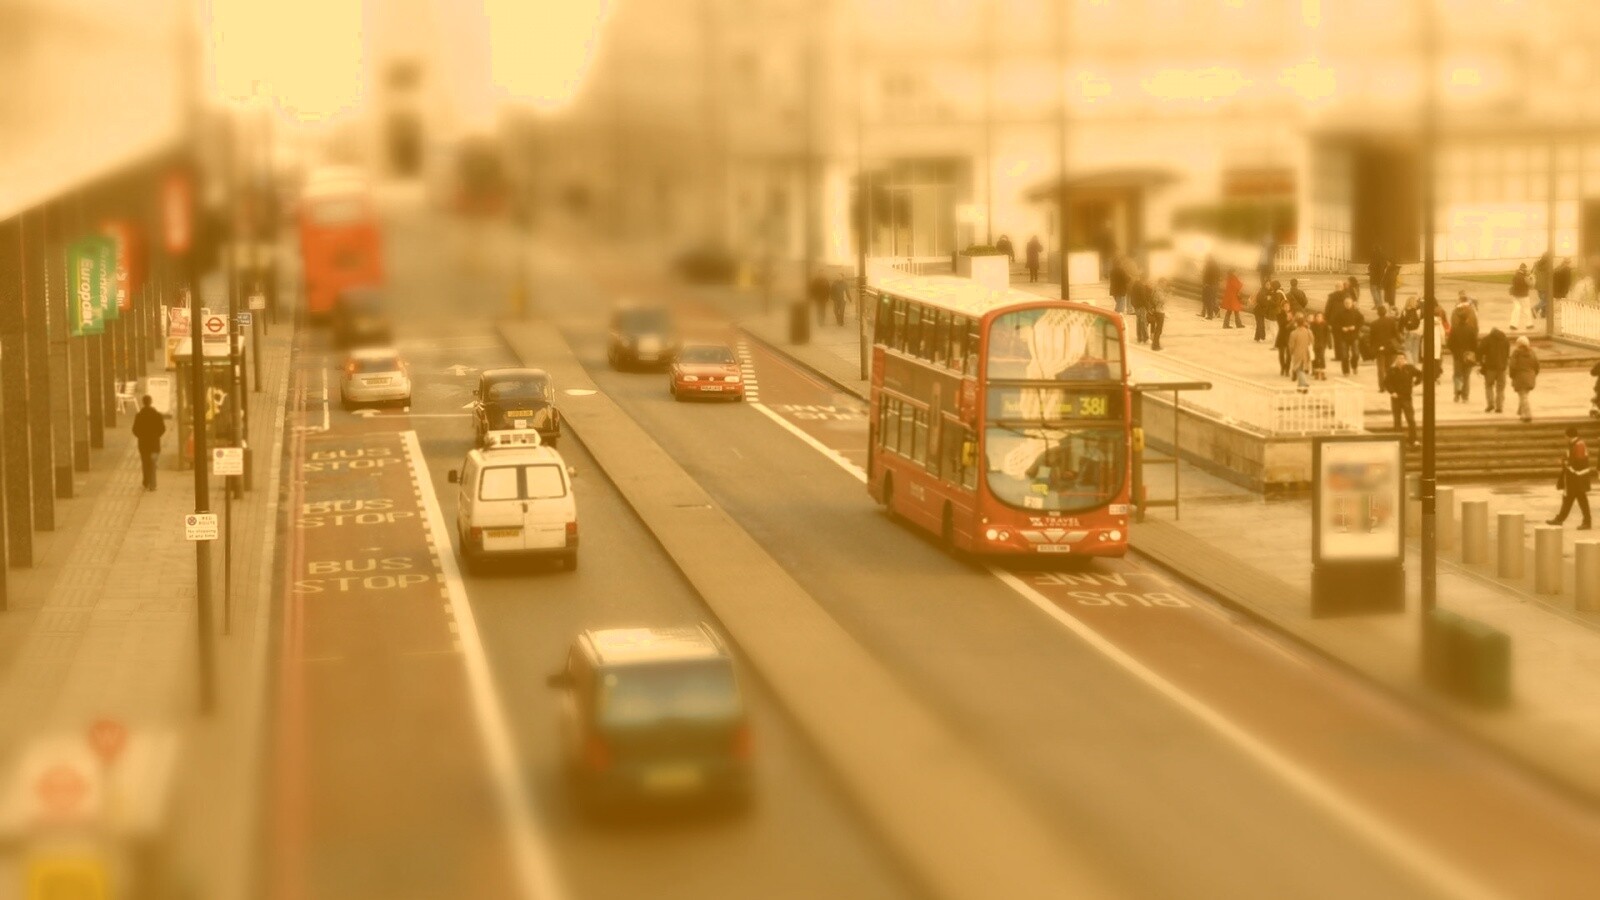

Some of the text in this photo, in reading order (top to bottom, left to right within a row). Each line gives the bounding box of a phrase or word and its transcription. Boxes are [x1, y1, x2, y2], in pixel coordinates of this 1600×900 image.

[77, 257, 94, 327] Europcar
[1079, 397, 1106, 416] 381
[311, 448, 392, 461] BUS
[302, 458, 402, 472] STOP
[302, 499, 394, 514] BUS
[296, 512, 415, 528] STOP
[308, 557, 413, 575] BUS
[293, 574, 430, 594] STOP
[1067, 591, 1192, 608] BUS
